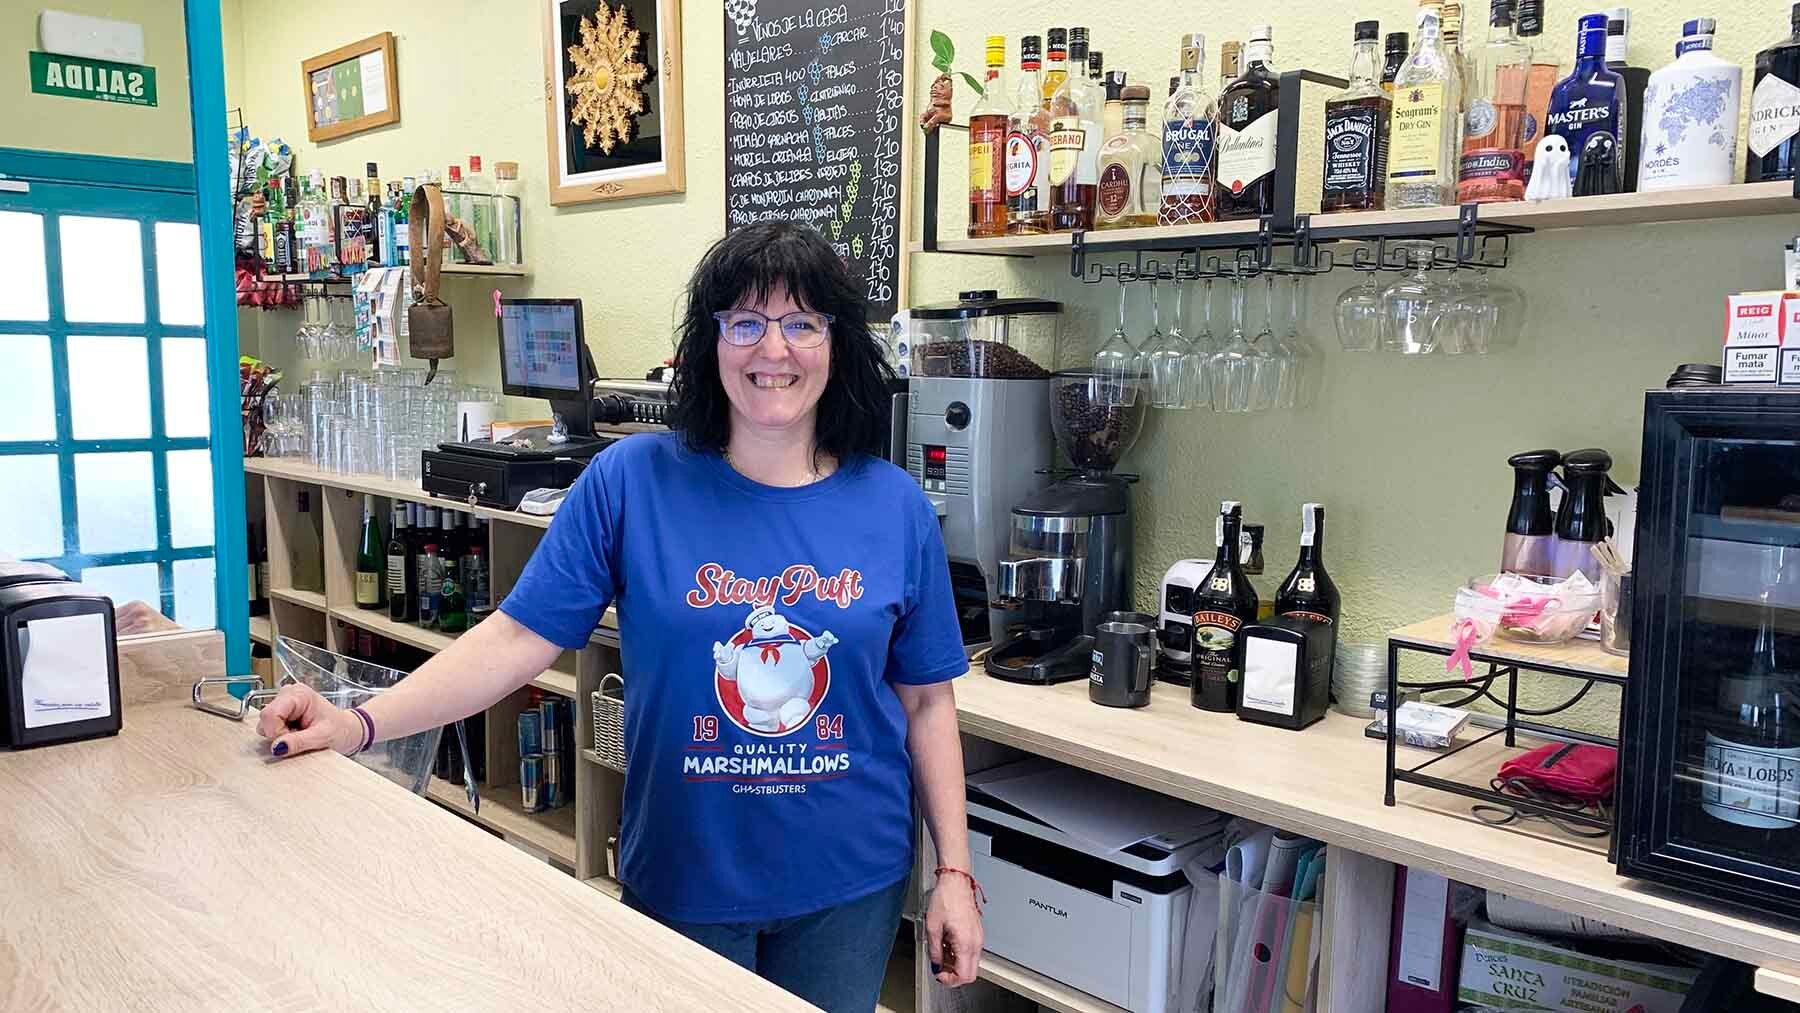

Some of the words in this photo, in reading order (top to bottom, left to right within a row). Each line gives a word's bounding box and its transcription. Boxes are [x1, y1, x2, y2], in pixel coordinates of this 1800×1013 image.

[799, 9, 814, 29] LA
[816, 4, 848, 27] CASA
[785, 67, 806, 83] 400
[754, 94, 766, 108] DE
[1395, 105, 1438, 119] Seagram's
[1548, 106, 1610, 125] MASTER'S
[1327, 123, 1345, 140] JACK
[1399, 120, 1414, 131] DRY
[1416, 120, 1431, 129] GIN
[1568, 122, 1582, 130] GIN
[1165, 129, 1210, 142] BRUGAL
[1478, 156, 1510, 169] Indias
[1740, 306, 1769, 316] REIG
[1736, 351, 1768, 361] Fumar
[687, 563, 783, 608] Stay
[782, 564, 864, 608] Puft
[1194, 613, 1238, 628] BAILEYS
[693, 715, 718, 742] 19
[816, 714, 844, 741] 84
[734, 743, 808, 755] QUALITY
[683, 753, 850, 775] MARSHMALLOWS
[1748, 766, 1794, 783] LOBOS
[1029, 898, 1068, 918] PANTUM
[1493, 981, 1537, 1002] CRUZ
